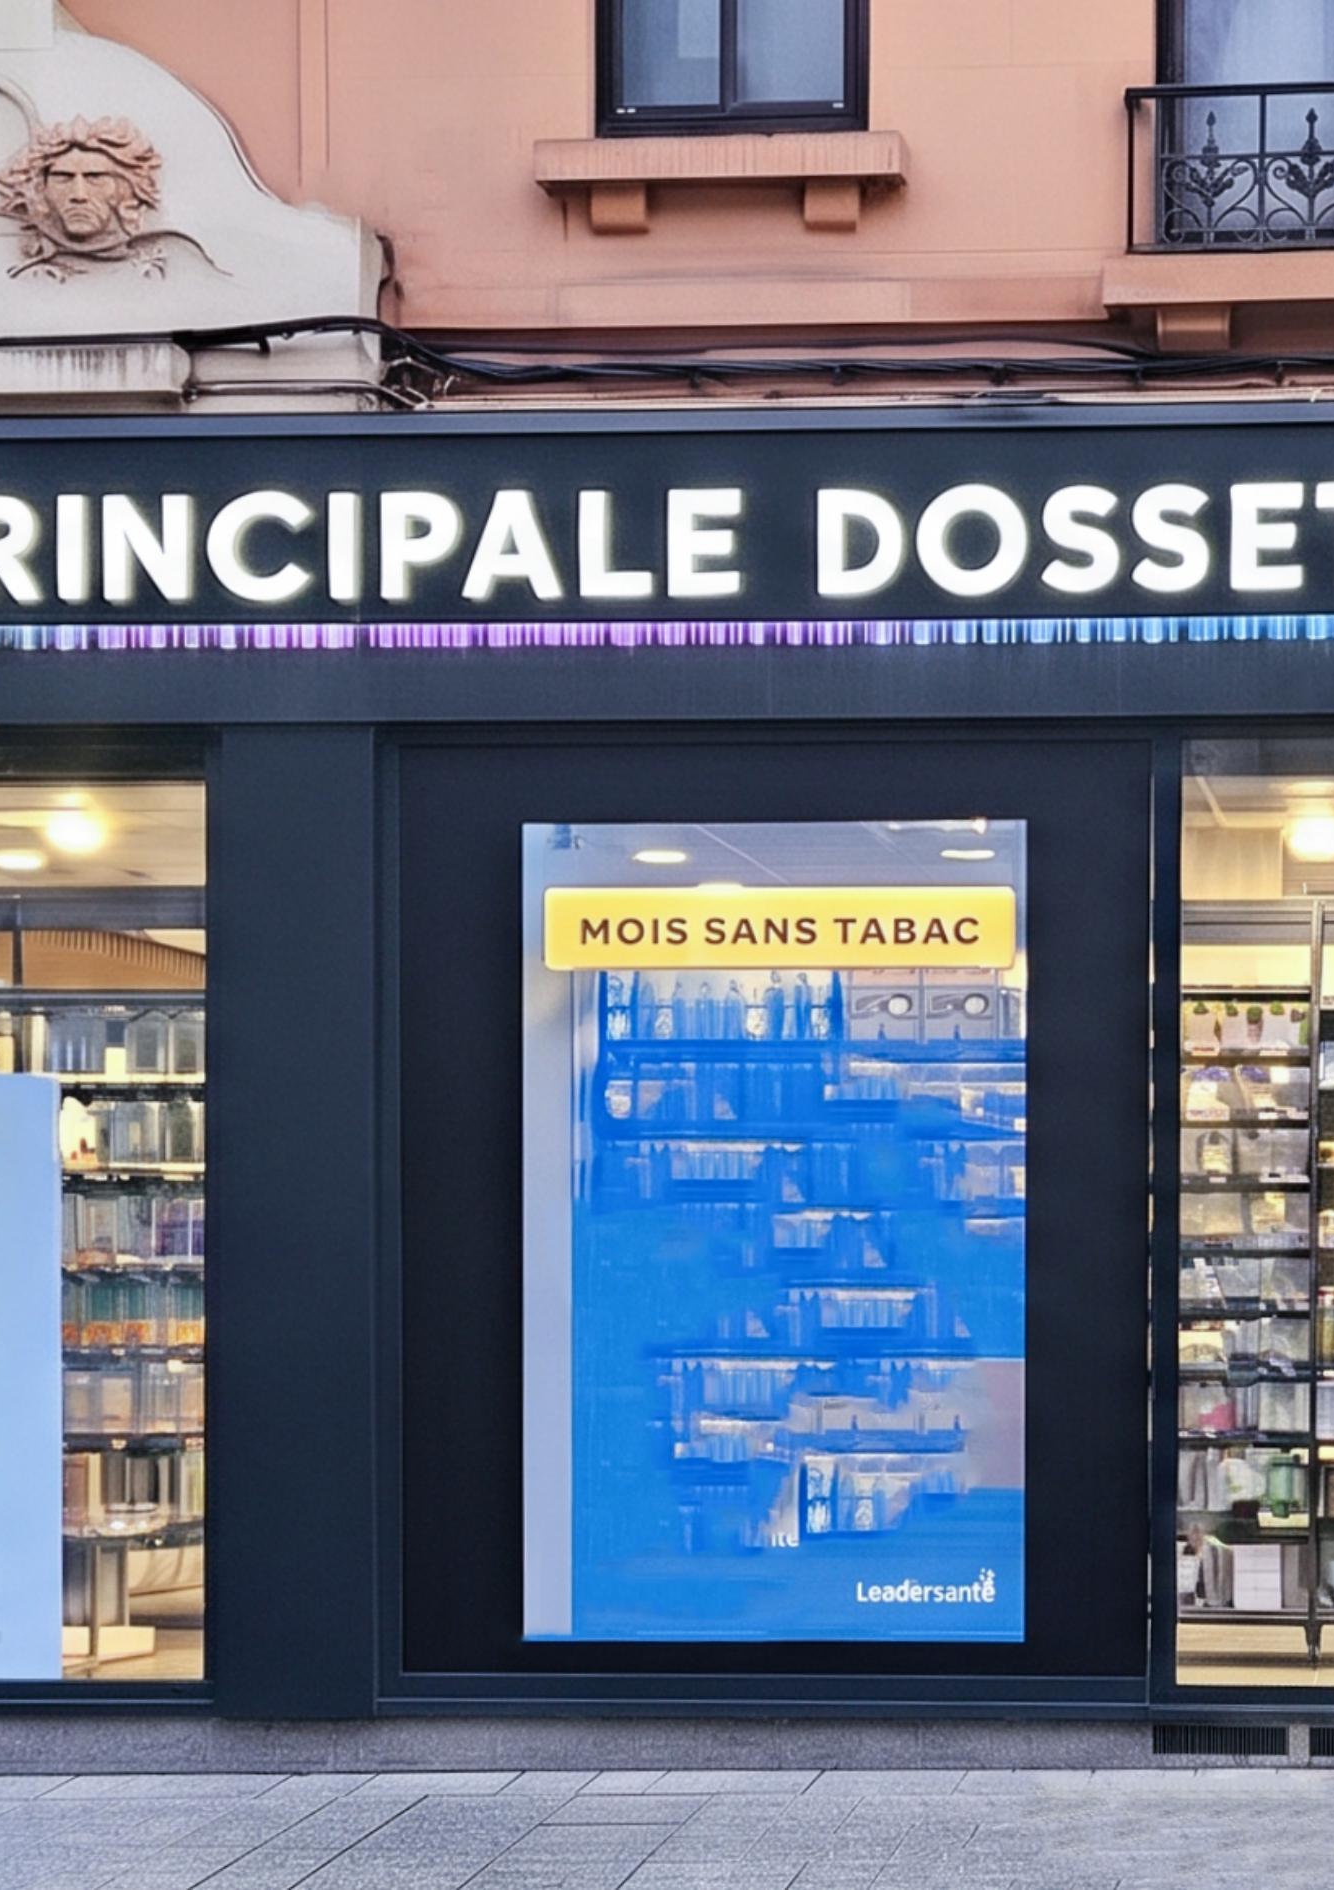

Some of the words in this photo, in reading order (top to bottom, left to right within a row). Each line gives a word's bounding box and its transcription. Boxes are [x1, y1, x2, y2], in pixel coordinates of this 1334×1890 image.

[580, 917, 689, 946] MOIS
[703, 917, 818, 946] SANS
[833, 917, 981, 946] TABAC
